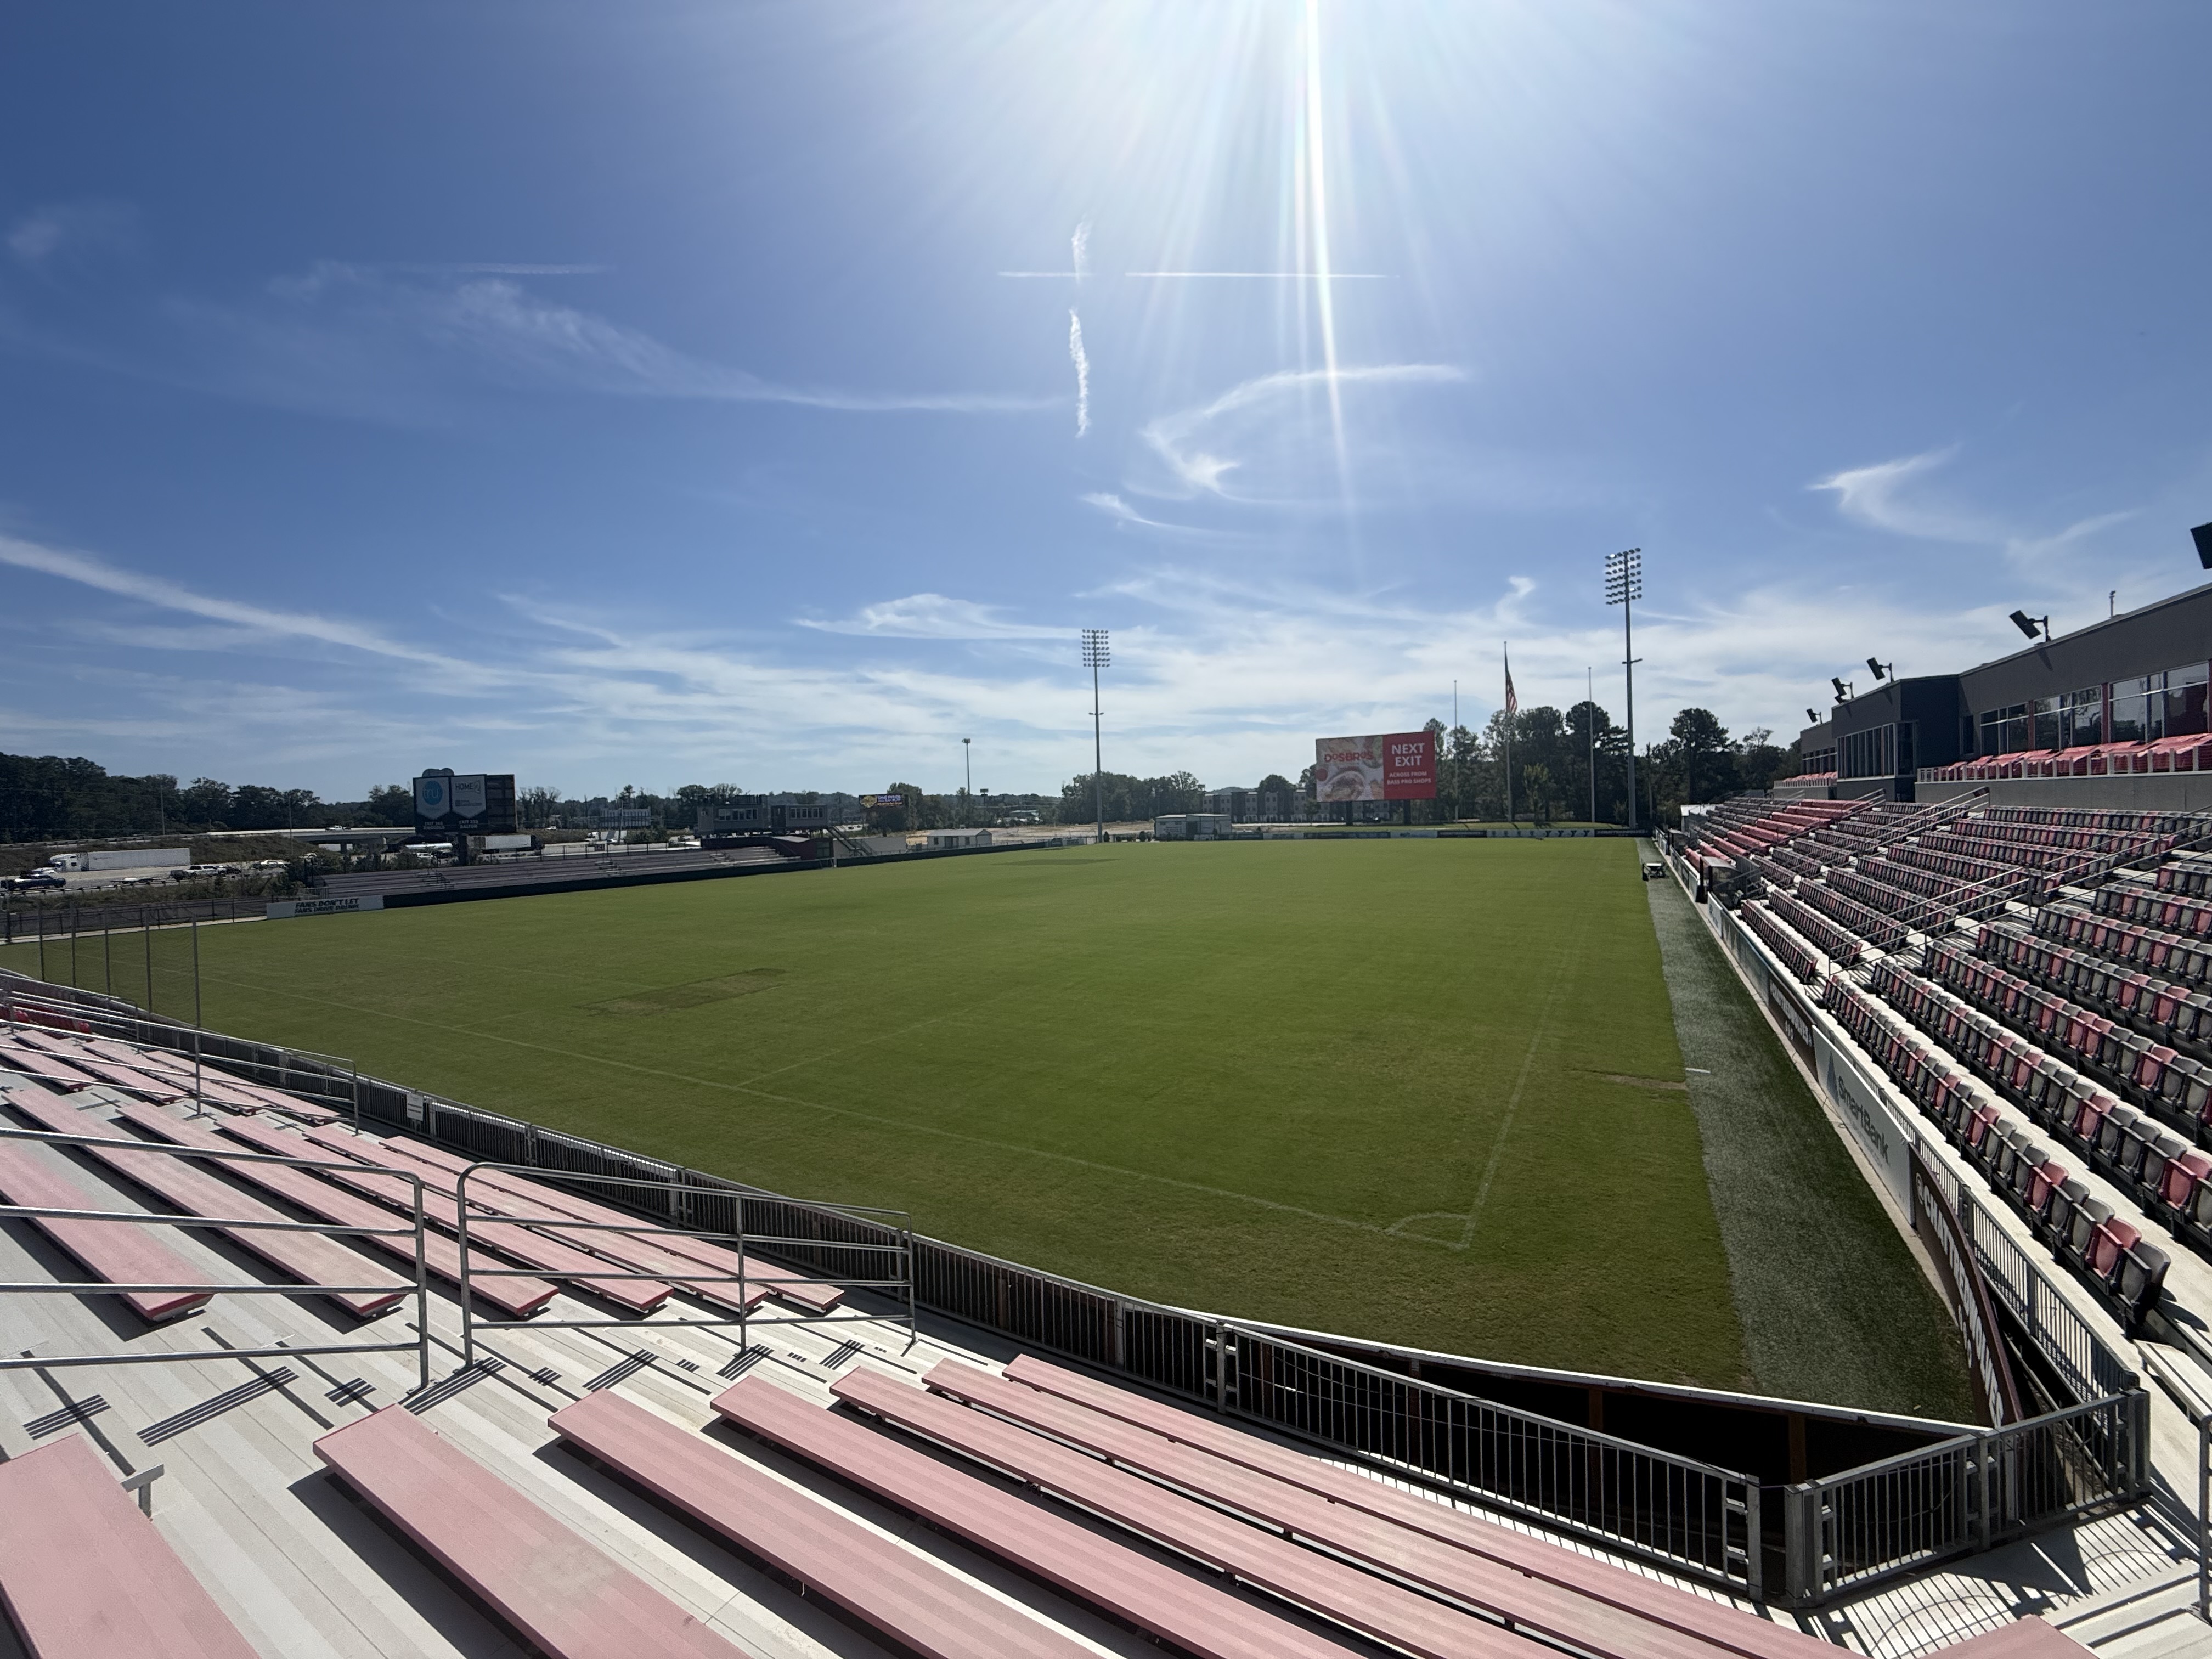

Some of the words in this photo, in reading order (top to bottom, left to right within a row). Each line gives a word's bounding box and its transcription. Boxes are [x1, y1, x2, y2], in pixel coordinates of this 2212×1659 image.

[1391, 743, 1425, 754] NEXT
[1395, 755, 1422, 766] EXIT
[1838, 1076, 1890, 1165] SmartBank
